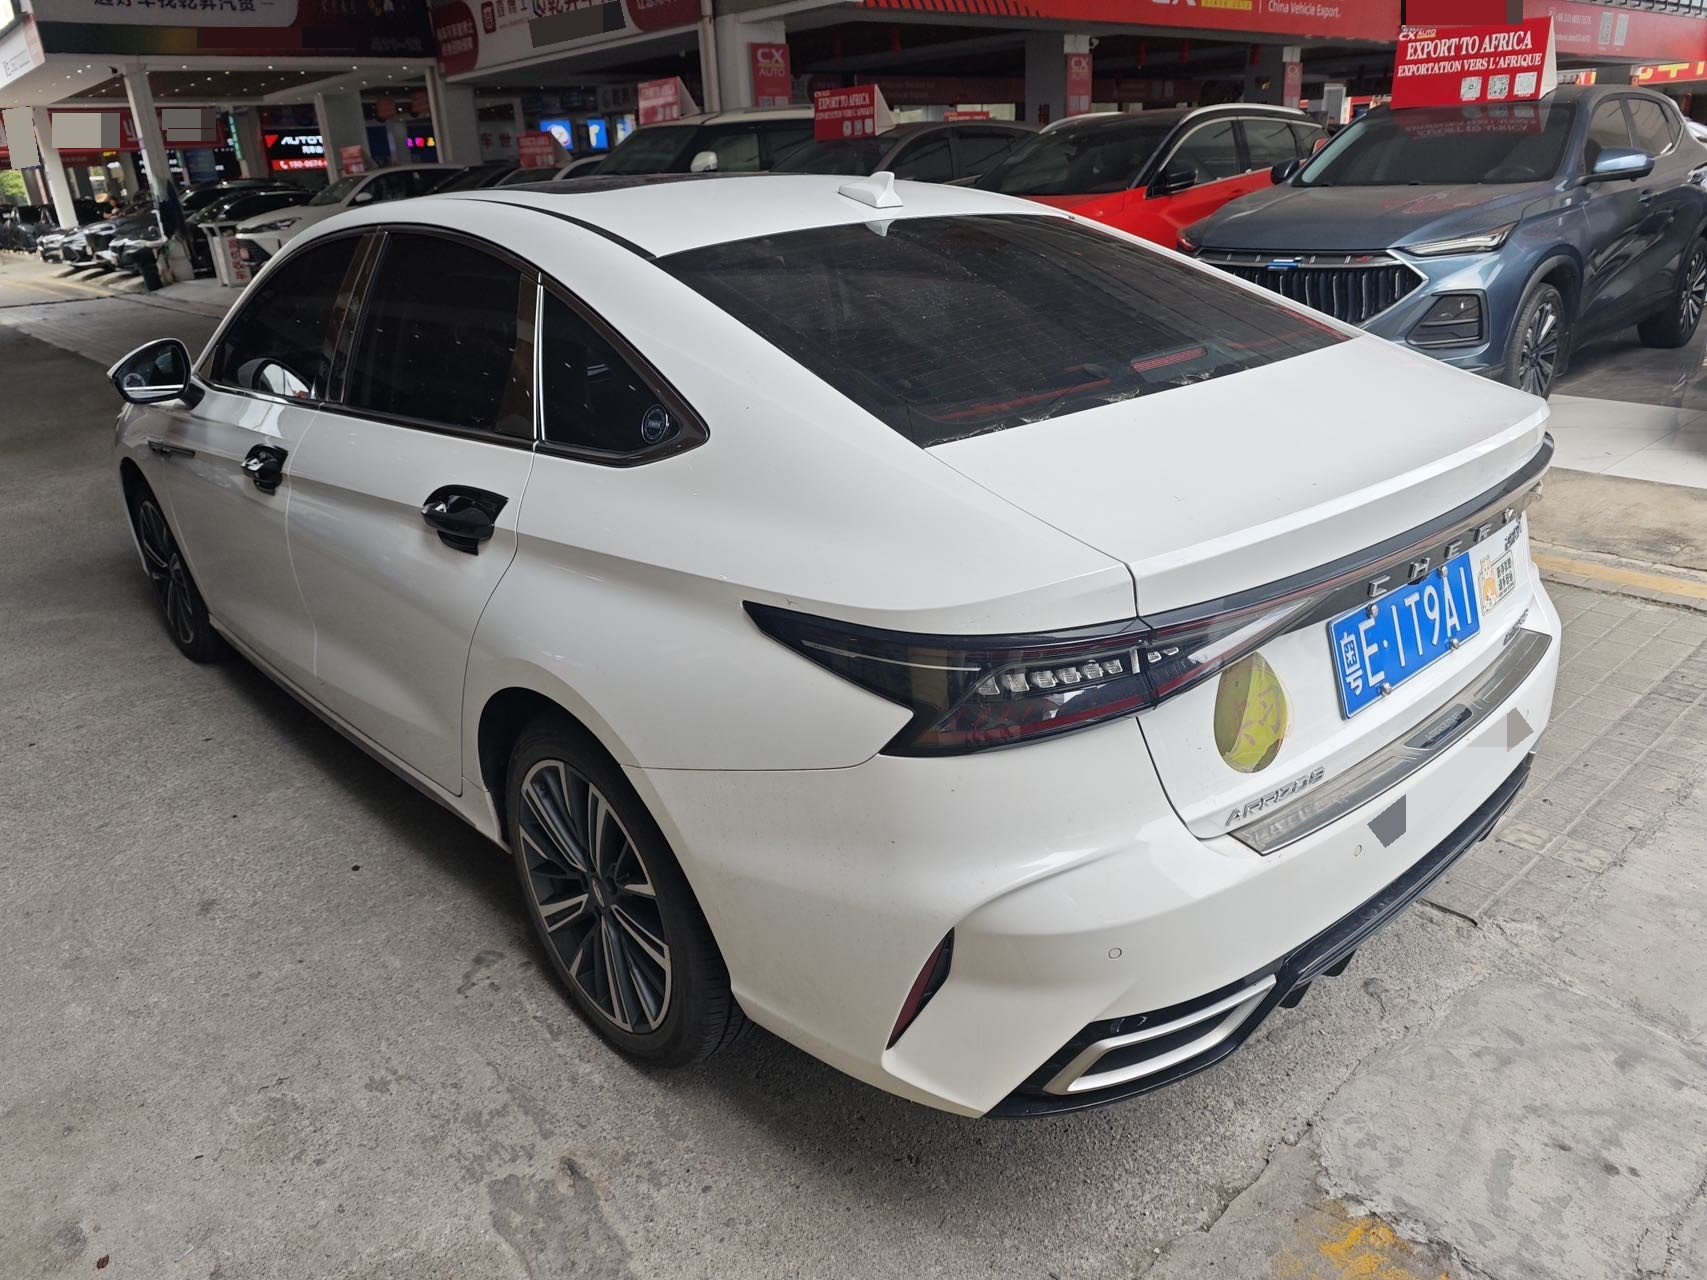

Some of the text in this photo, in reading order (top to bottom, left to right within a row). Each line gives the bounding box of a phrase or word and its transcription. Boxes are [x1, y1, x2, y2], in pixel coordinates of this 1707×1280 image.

[1268, 1, 1288, 13] China
[1291, 2, 1315, 15] Vehicle
[1399, 32, 1415, 40] CX
[1406, 39, 1459, 60] EXPORT
[1460, 36, 1479, 55] TO
[1480, 31, 1533, 53] AFRICA
[757, 48, 784, 63] CX
[1397, 53, 1543, 77] EXPORTATION VERS L'AFRIQUE
[760, 68, 785, 77] AUTO
